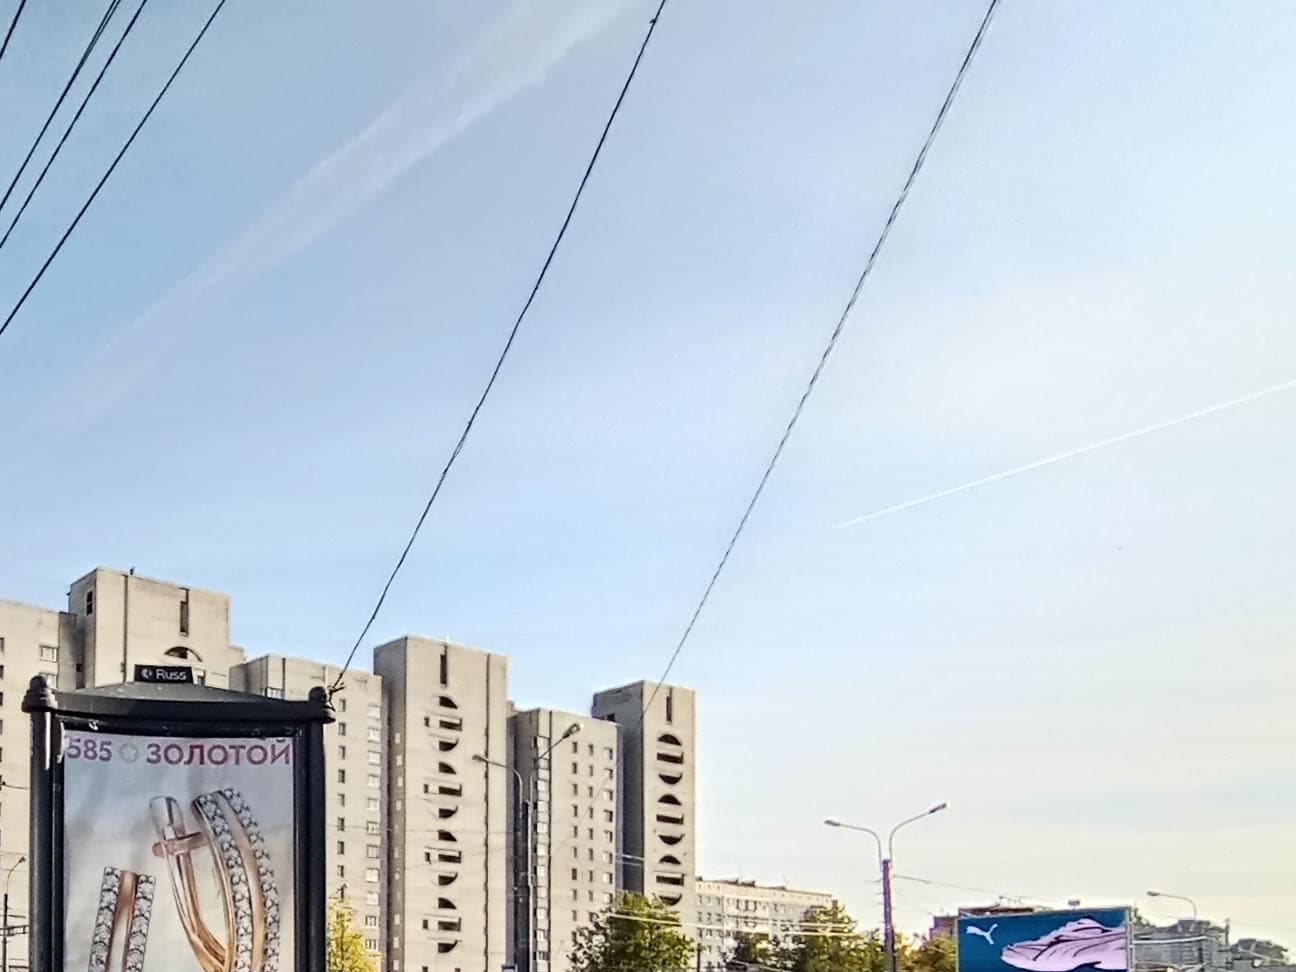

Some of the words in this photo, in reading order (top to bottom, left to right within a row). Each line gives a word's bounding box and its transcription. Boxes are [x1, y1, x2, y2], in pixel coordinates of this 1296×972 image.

[156, 668, 187, 680] Russ
[67, 738, 113, 762] 585
[146, 737, 291, 765] ЗОЛОТОЙ
